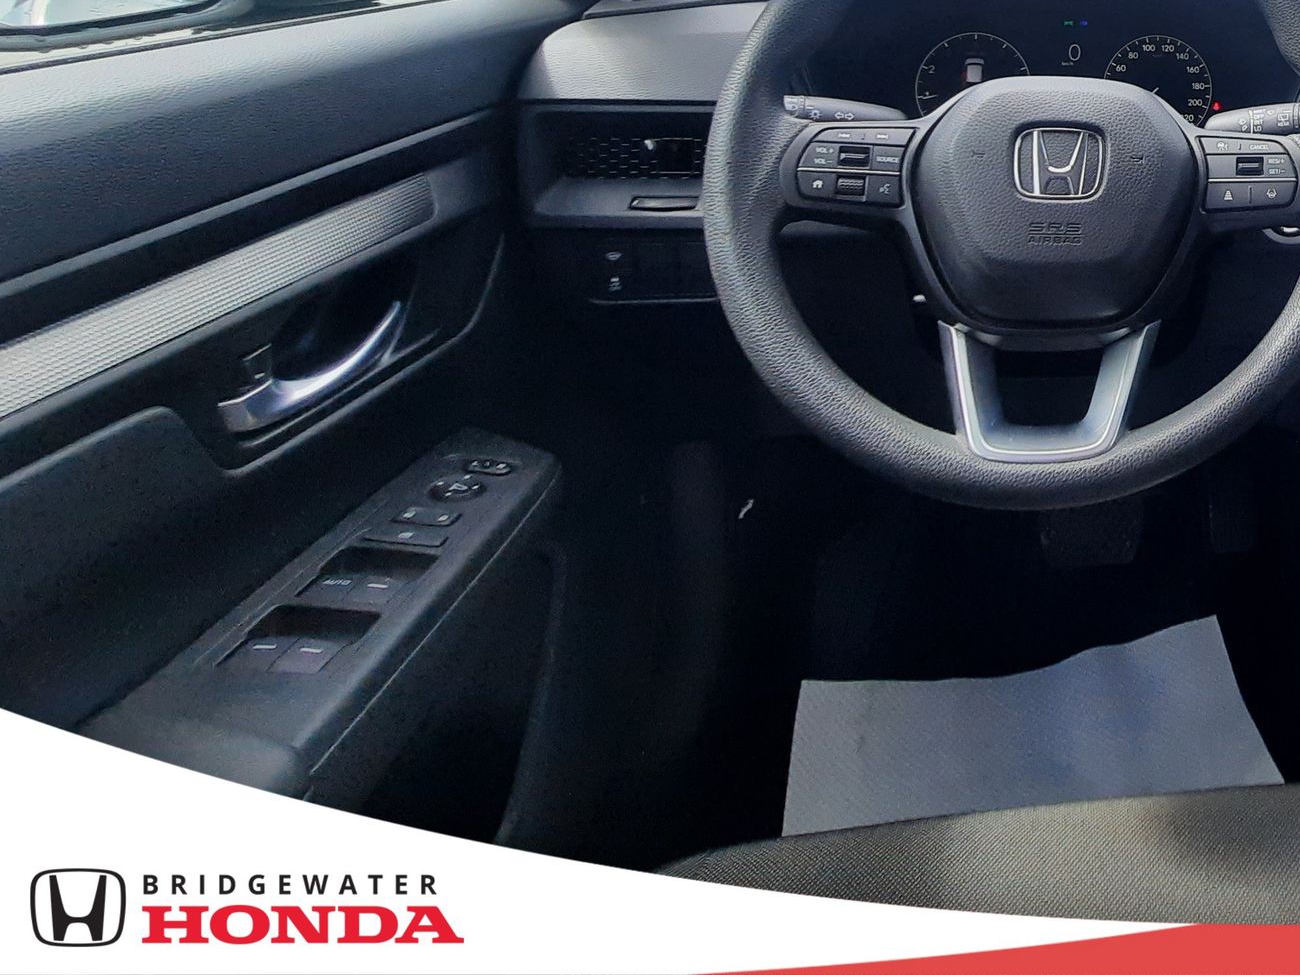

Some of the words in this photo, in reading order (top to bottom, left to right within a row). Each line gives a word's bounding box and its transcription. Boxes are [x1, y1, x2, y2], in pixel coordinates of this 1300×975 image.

[1068, 43, 1081, 62] 0
[1142, 44, 1156, 53] 100
[1161, 44, 1175, 53] 120
[1127, 51, 1139, 60] 80
[1175, 52, 1190, 61] 140
[1115, 64, 1127, 73] 60
[1186, 65, 1200, 74] 160
[1191, 82, 1205, 91] 180
[1187, 98, 1203, 107] 200
[876, 156, 900, 164] SOURCE
[1028, 221, 1083, 233] SRS
[1027, 235, 1083, 246] AIRBAG
